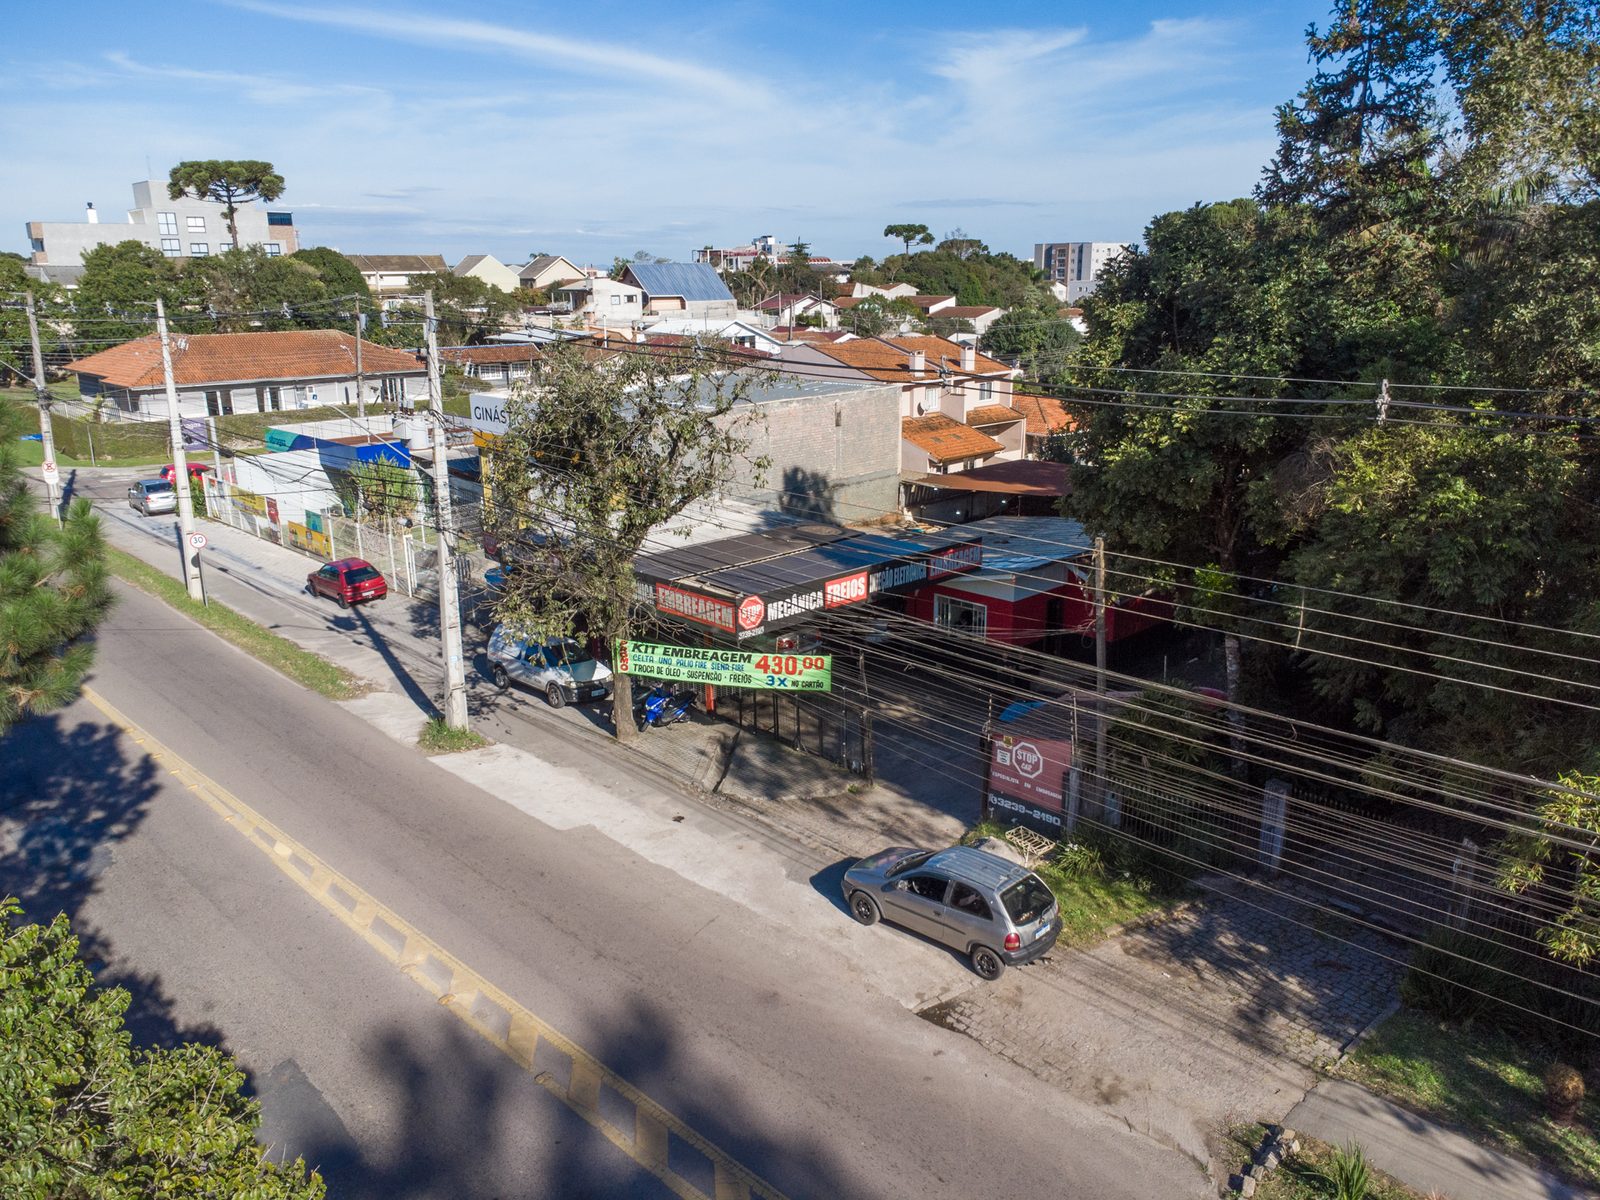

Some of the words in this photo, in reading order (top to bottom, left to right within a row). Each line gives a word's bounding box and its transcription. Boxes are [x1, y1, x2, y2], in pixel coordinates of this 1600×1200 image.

[193, 536, 203, 544] 30
[827, 577, 865, 604] FREIOS
[658, 587, 734, 628] EMBREAGEM
[741, 604, 762, 618] STOP
[767, 590, 824, 621] MECÂNICA
[632, 643, 658, 654] KIT
[662, 646, 752, 663] EMBREAGEM
[633, 654, 654, 663] CELTA
[659, 657, 672, 665] UNO
[676, 659, 693, 668] PALIO
[695, 661, 707, 670] FIRE
[711, 662, 729, 671] SIENA
[732, 664, 744, 672] FIRE
[754, 655, 825, 676] 430,00
[633, 664, 654, 673] TROCA
[657, 667, 663, 675] DE
[665, 665, 681, 677] ÓLEO
[687, 670, 722, 682] SUSPENSÃO
[729, 674, 752, 684] FREIOS
[791, 680, 799, 688] NO
[801, 680, 824, 689] CARTÃO
[1016, 750, 1038, 765] STOP
[1021, 762, 1033, 771] CAR
